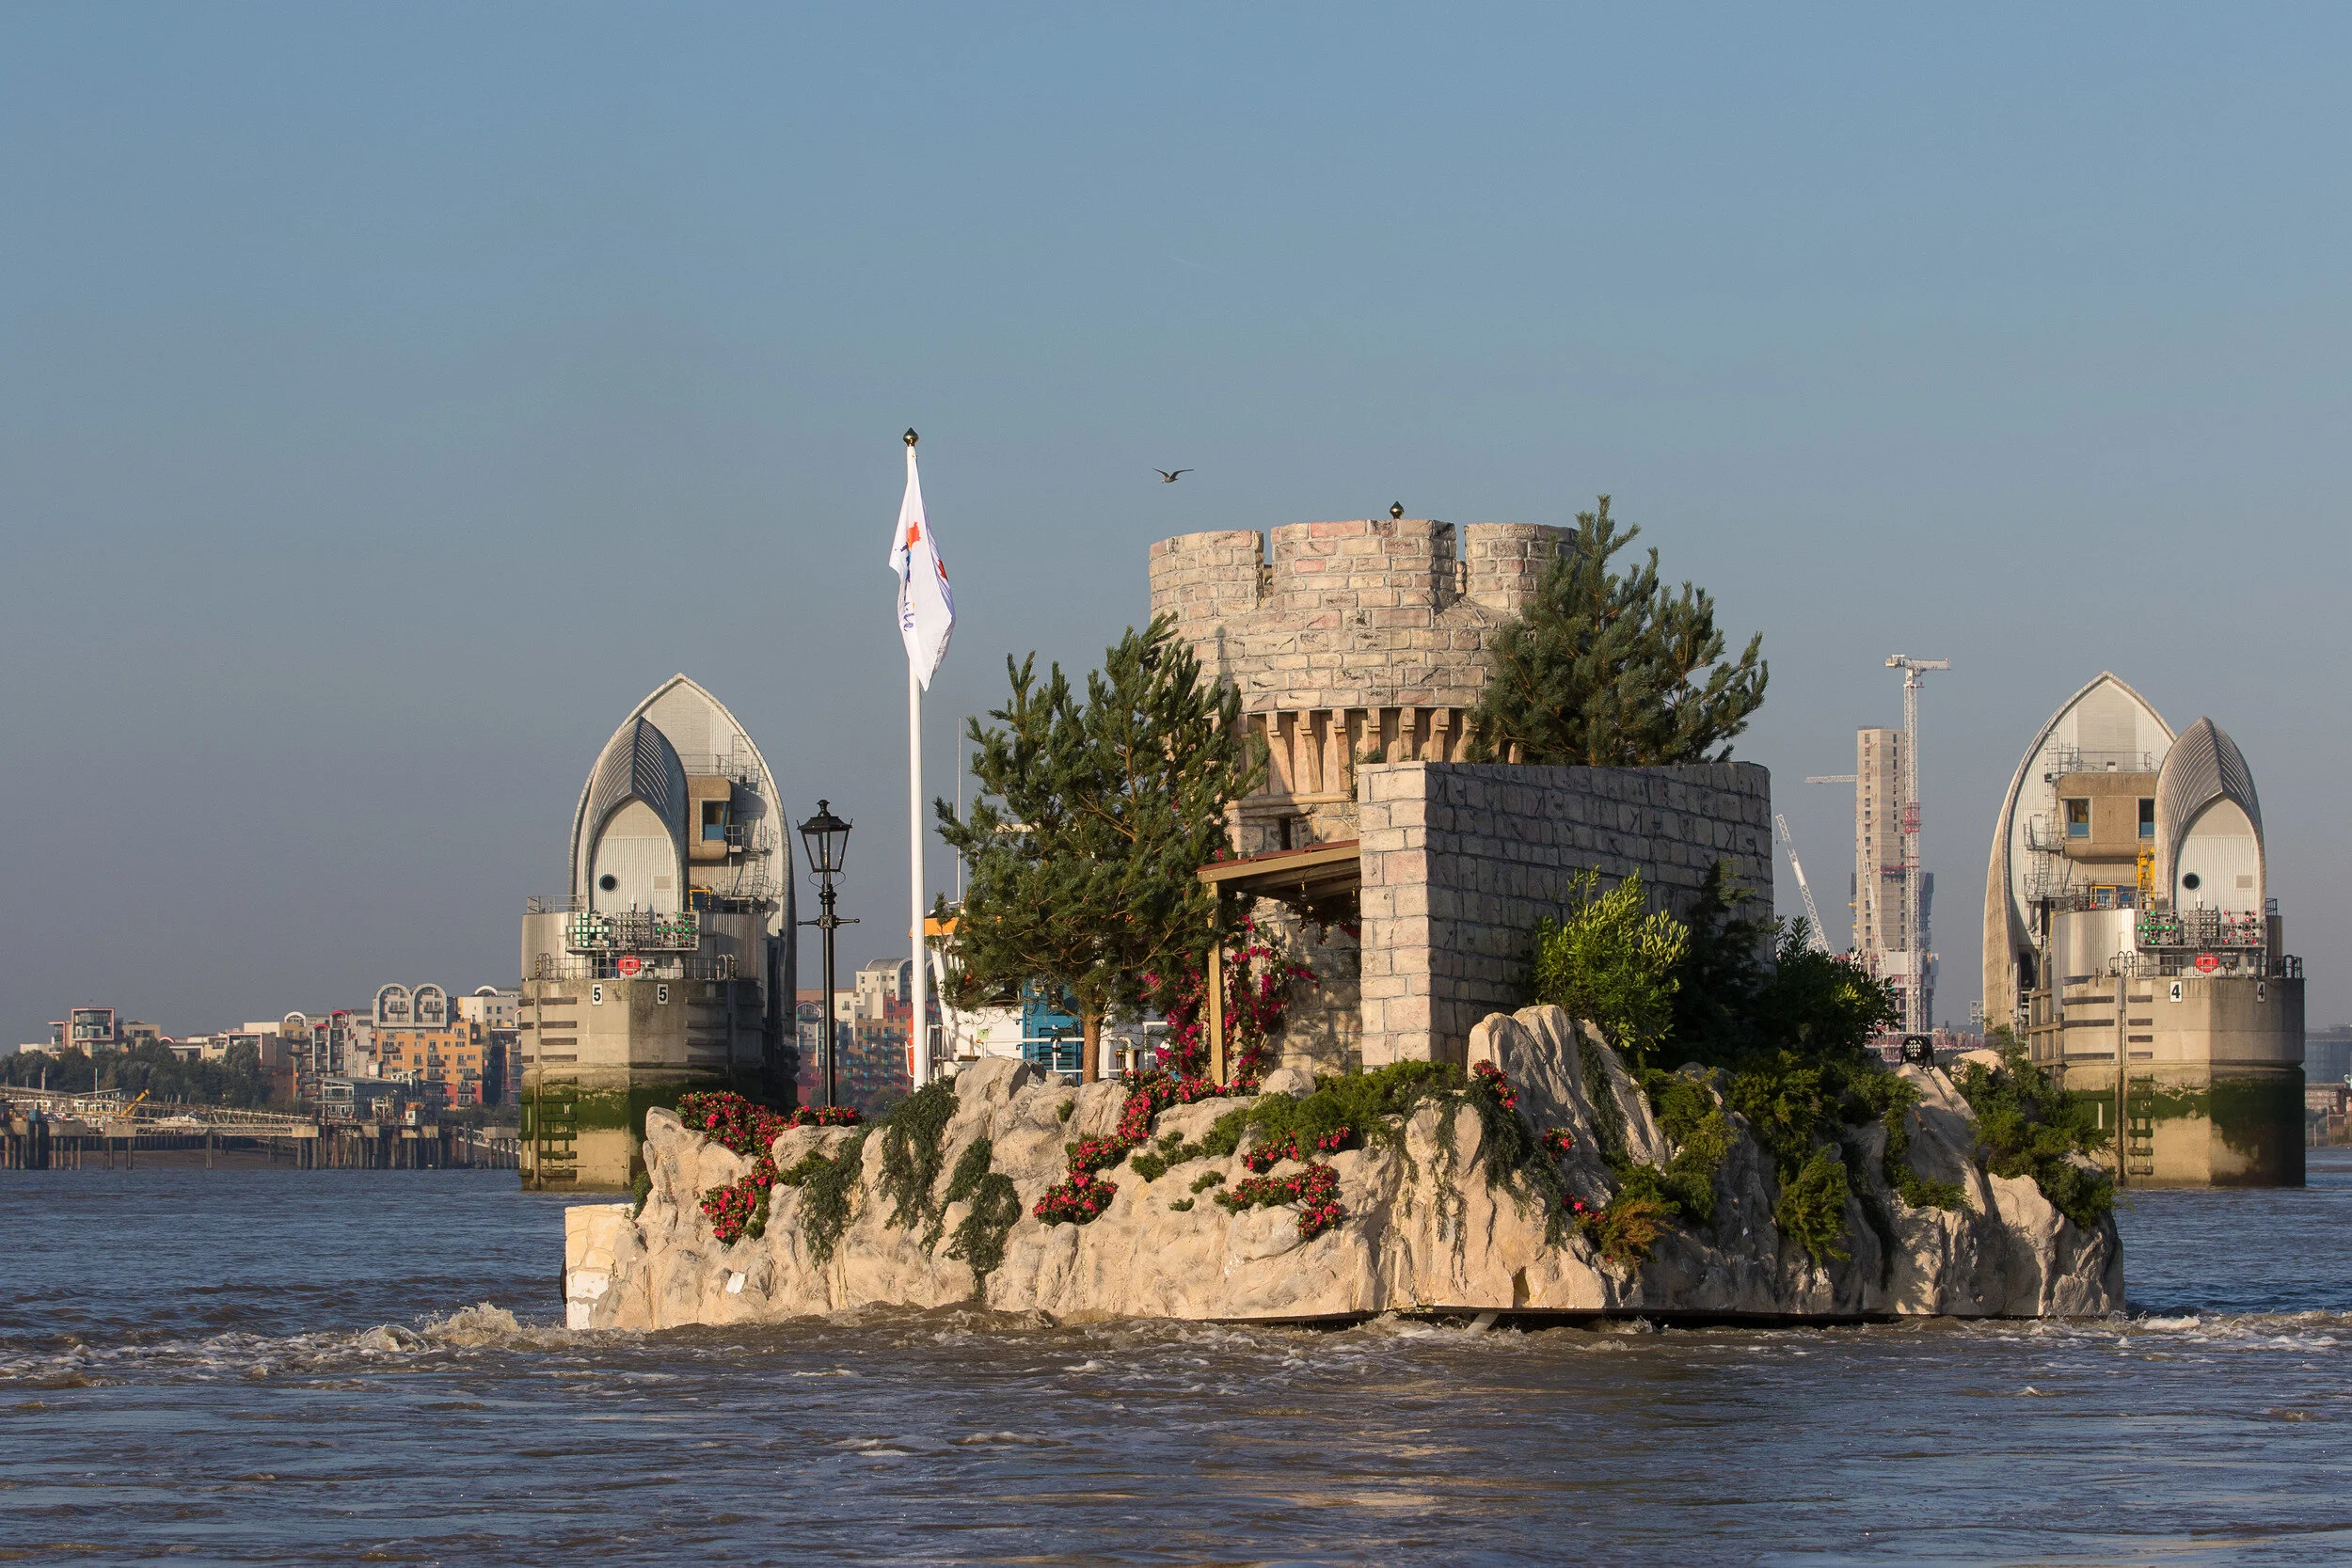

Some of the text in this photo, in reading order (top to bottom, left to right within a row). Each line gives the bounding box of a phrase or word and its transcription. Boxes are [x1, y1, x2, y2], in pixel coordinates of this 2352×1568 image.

[593, 987, 601, 1001] 5
[658, 987, 667, 1002] 5
[2171, 984, 2180, 999] 4
[2258, 984, 2265, 999] 4
